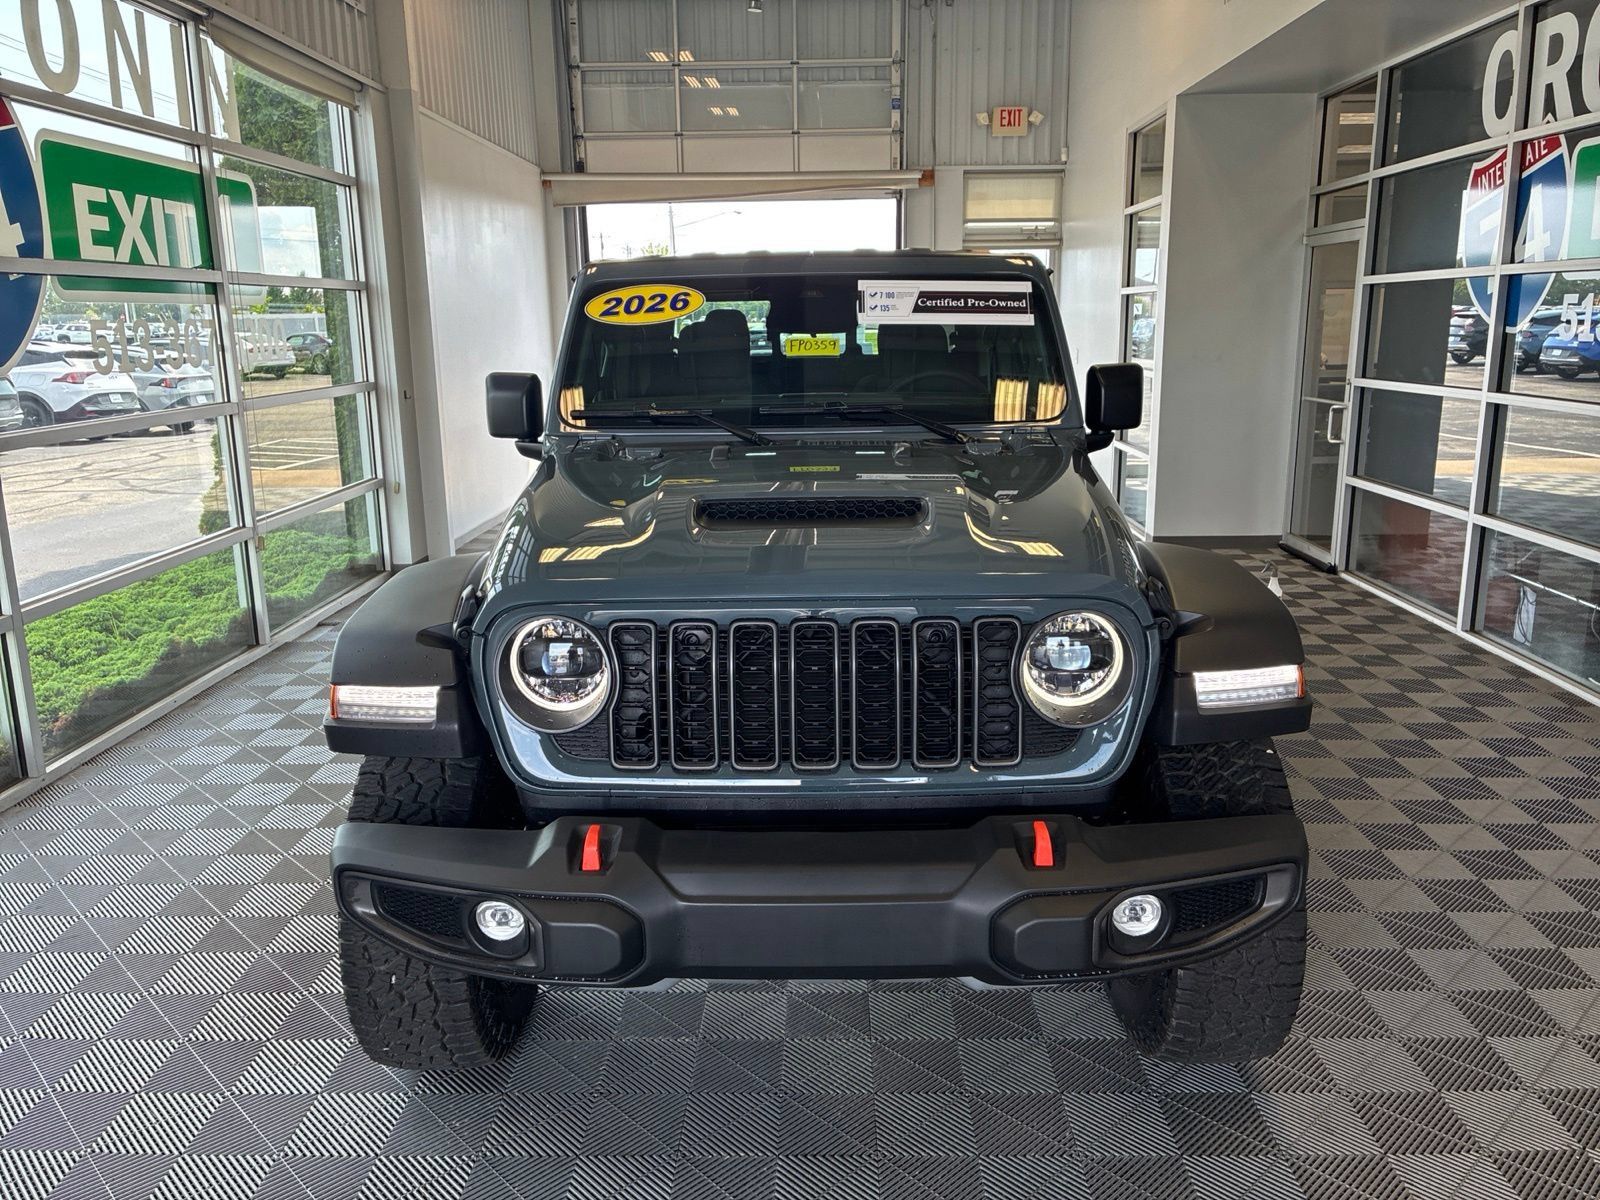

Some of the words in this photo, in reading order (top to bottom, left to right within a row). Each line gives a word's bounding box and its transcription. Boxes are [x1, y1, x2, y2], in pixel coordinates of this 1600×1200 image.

[1000, 109, 1023, 127] EXIT
[72, 183, 203, 269] EXIT
[598, 291, 693, 317] 2026
[880, 304, 890, 312] 135
[918, 297, 964, 308] Certified
[967, 298, 1026, 308] Pre-Owned
[1559, 293, 1600, 342] 51
